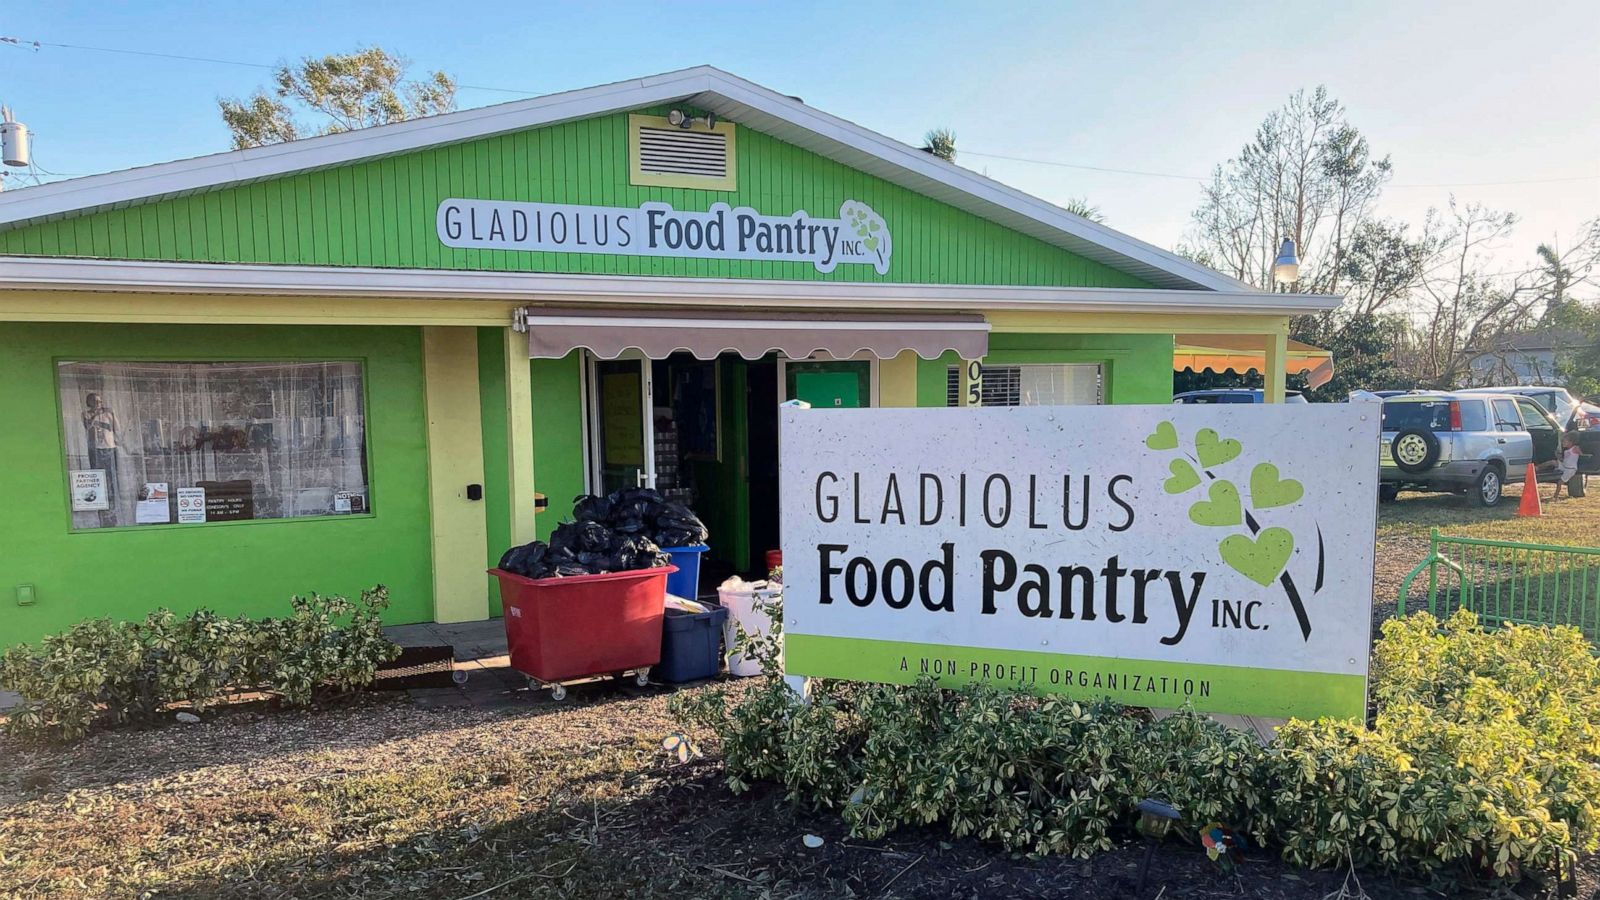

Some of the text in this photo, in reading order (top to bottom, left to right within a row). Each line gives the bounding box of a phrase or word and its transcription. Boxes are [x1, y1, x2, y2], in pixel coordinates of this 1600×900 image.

[445, 205, 865, 265] GLADIOLUS Food Pantry INC.
[815, 471, 1135, 531] GLADIOLUS
[816, 543, 1270, 646] Food Pantry INC.
[900, 656, 1210, 697] A NON-PROFIT ORGANIZATION
